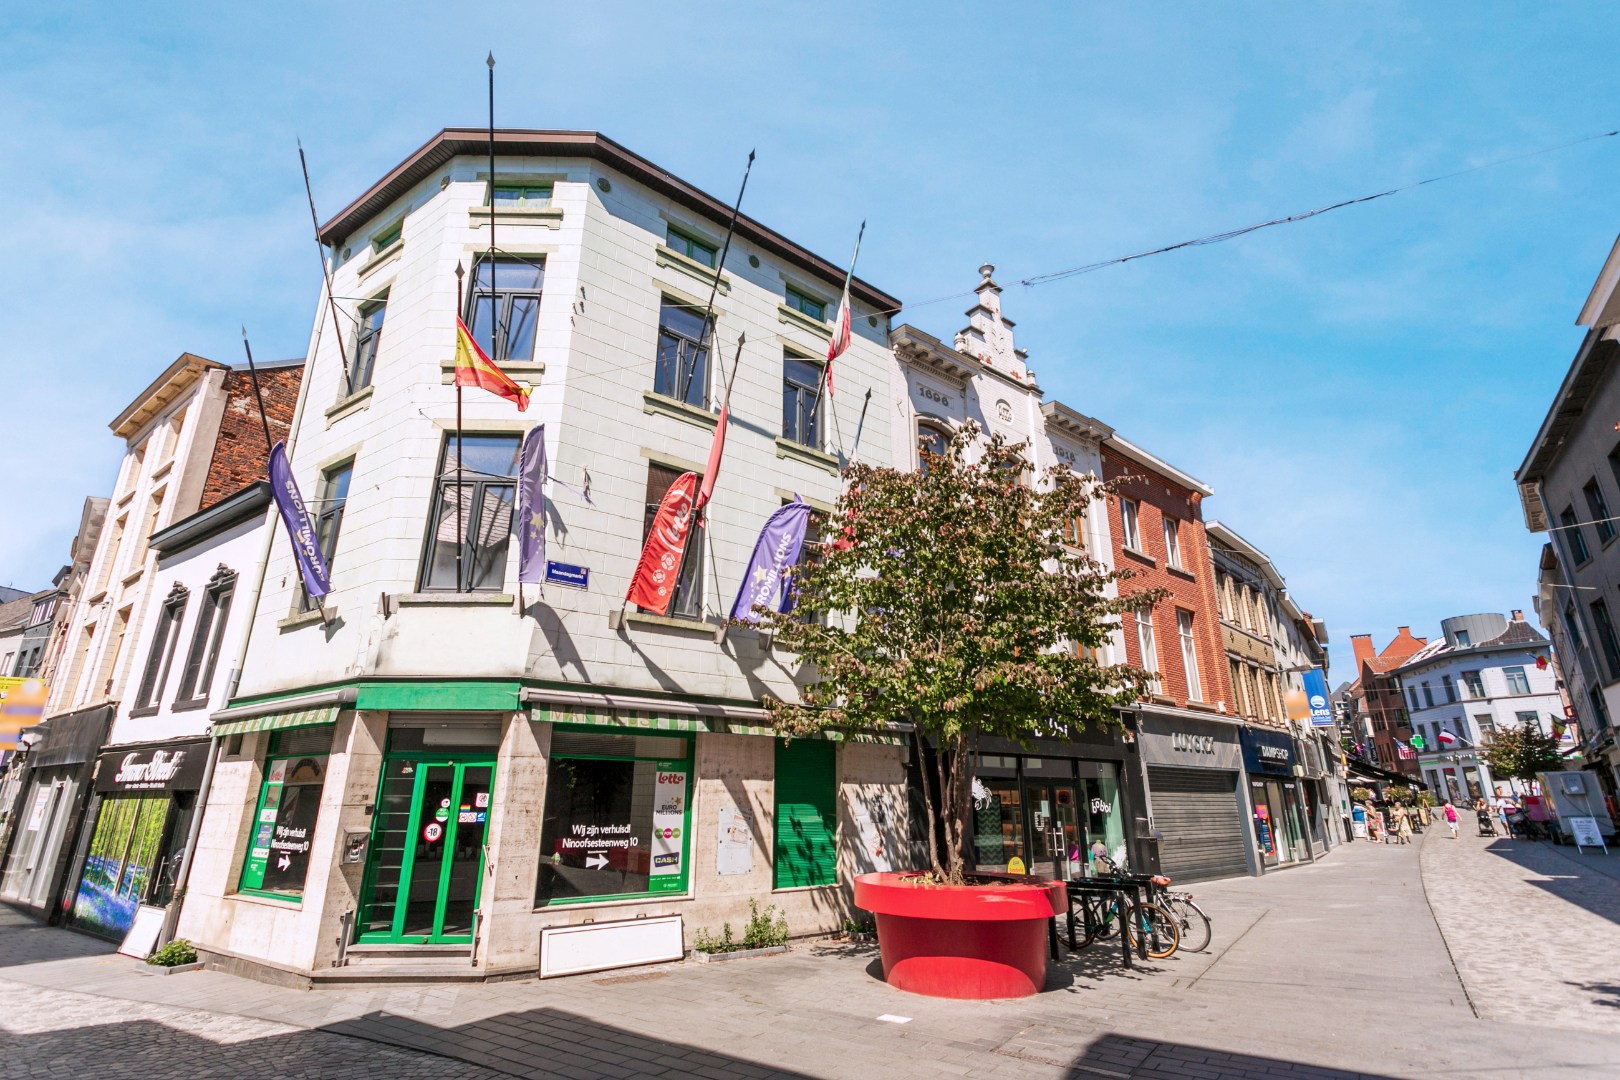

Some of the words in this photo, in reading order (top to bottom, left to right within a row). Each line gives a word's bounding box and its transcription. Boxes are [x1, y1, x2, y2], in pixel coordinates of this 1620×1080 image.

[284, 480, 325, 582] EUROMILLIONS
[748, 532, 792, 619] EROMILLIONS
[1311, 708, 1330, 717] Lens
[1091, 799, 1112, 814] bobbi
[427, 827, 438, 837] -18
[572, 823, 586, 837] Wij
[586, 825, 600, 837] zijn
[600, 823, 631, 835] verhuisd!
[562, 837, 629, 850] Ninoofsesteenweg
[629, 836, 639, 847] 10
[655, 856, 678, 864] CASH
